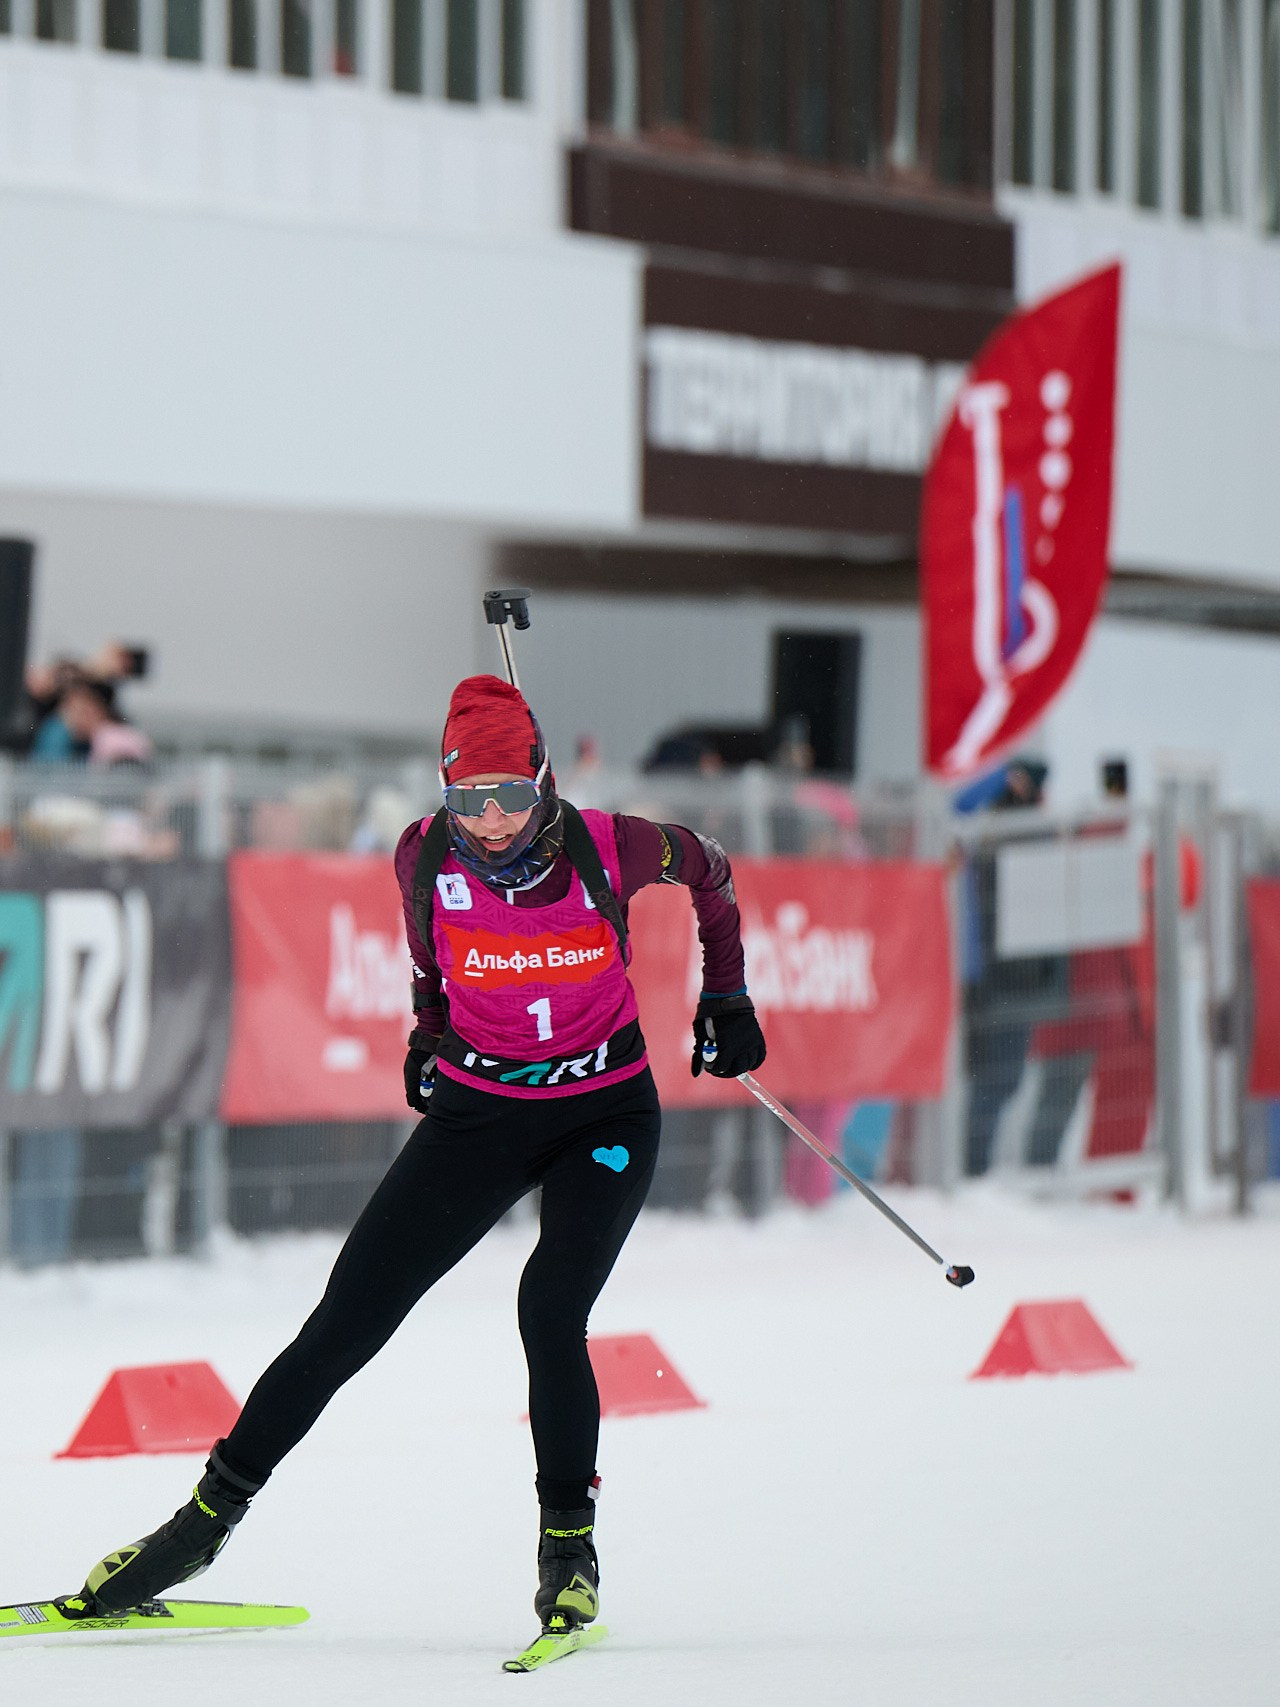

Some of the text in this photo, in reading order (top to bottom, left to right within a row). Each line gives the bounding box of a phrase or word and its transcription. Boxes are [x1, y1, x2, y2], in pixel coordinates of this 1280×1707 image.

[464, 946, 605, 974] Альфа Банк
[526, 997, 553, 1042] 1
[544, 1524, 593, 1537] FISCHER
